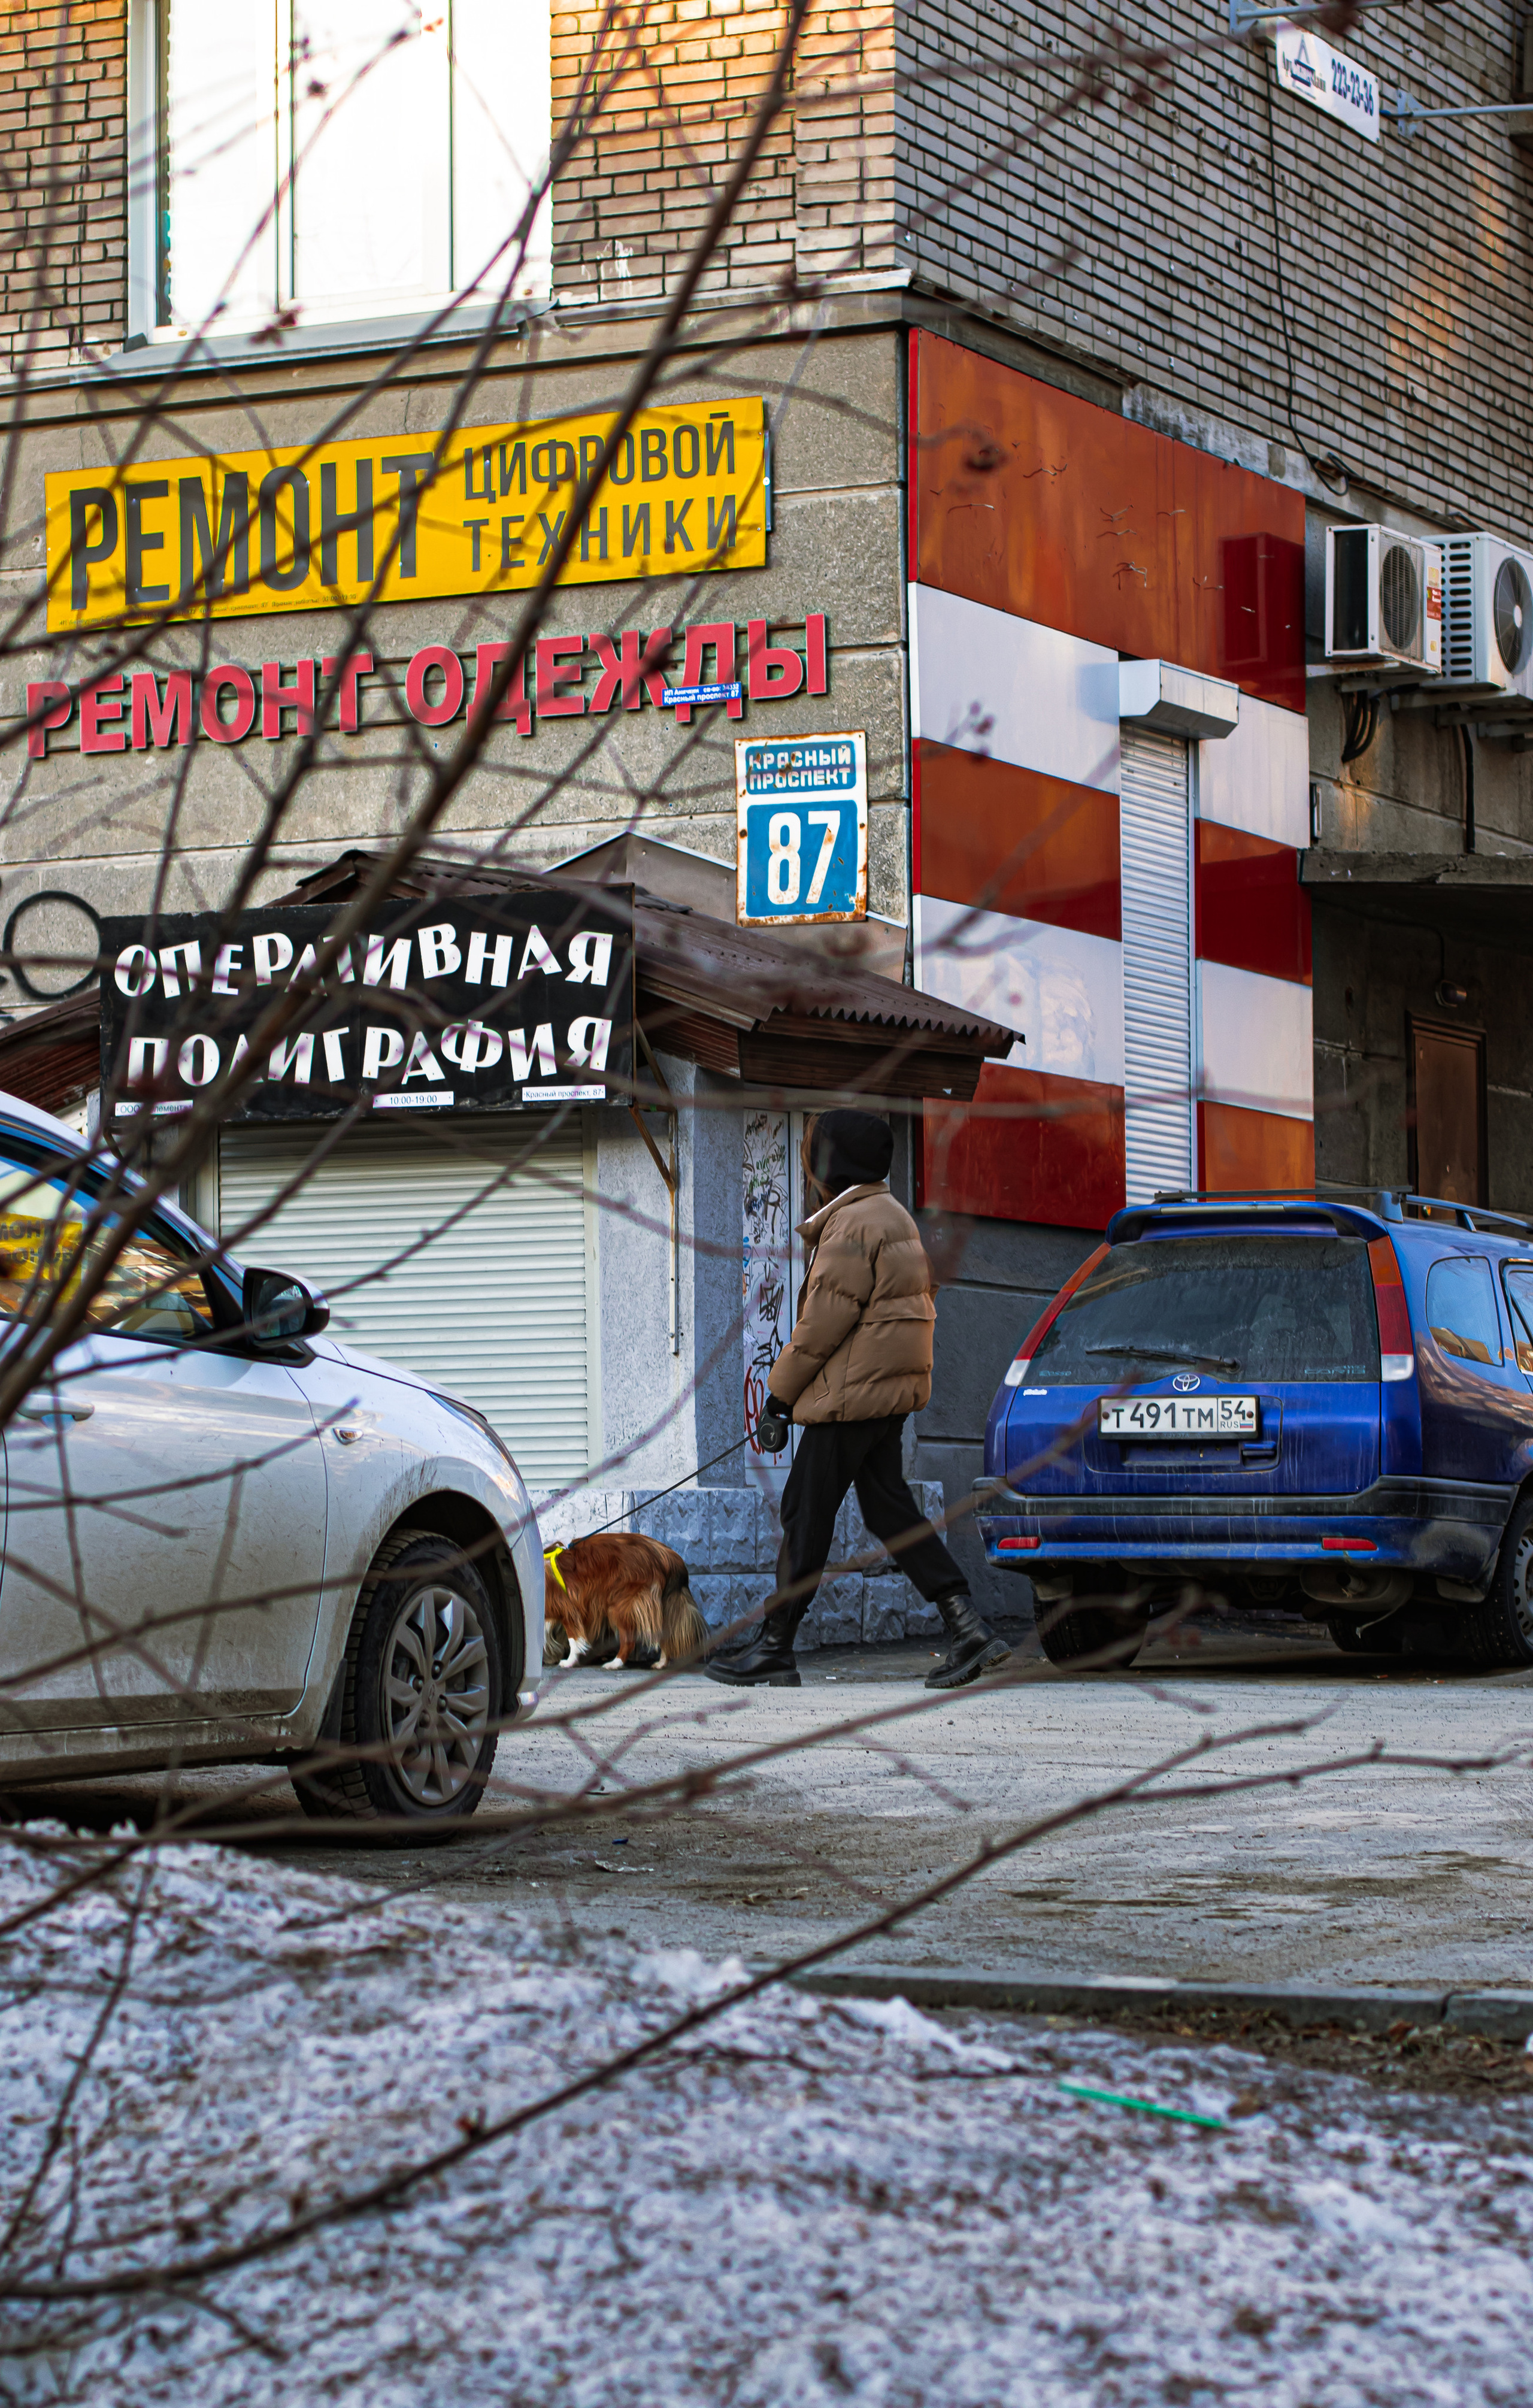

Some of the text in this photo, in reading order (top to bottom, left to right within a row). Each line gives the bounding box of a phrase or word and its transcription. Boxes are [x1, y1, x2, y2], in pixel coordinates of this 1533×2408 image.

[464, 411, 735, 503] ЦИФРОВОЙ
[69, 452, 435, 610] РЕМОНТ
[463, 494, 736, 571] ТЕХНИКИ
[26, 613, 826, 758] РЕМОНТ ОДЕЖДЫ
[664, 694, 696, 704] Красный
[697, 692, 729, 701] проспект
[749, 744, 851, 770] КРАСНЫЙ
[749, 767, 851, 790] ПРОСПЕКТ
[767, 810, 841, 905] 87
[390, 1094, 438, 1105] 10:00-19:00
[525, 1091, 556, 1099] Красный
[558, 1090, 591, 1099] проспект,
[1220, 1400, 1246, 1420] 54
[1220, 1420, 1239, 1429] RUS
